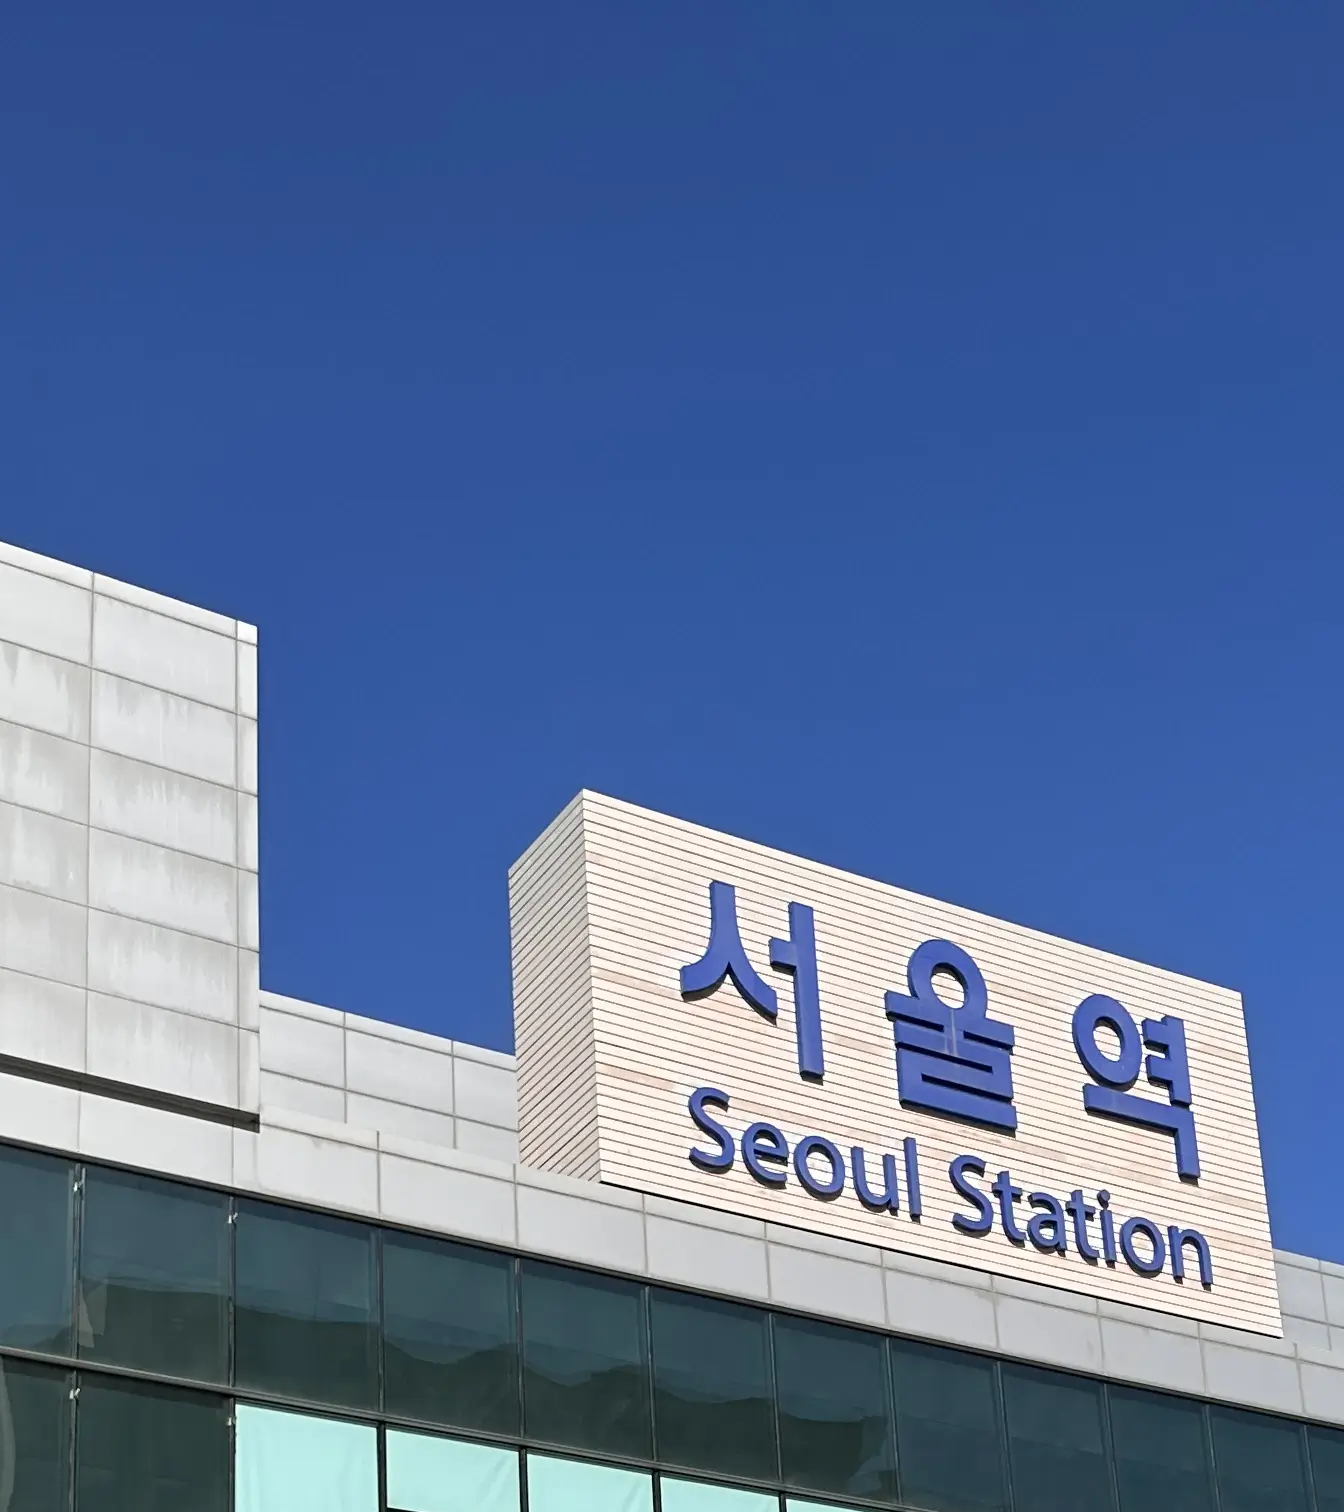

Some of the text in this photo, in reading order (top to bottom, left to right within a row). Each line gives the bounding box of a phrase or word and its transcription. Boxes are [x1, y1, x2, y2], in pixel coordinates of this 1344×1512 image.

[679, 880, 1199, 1184] 서울역
[687, 1086, 1214, 1289] Seoul Station
